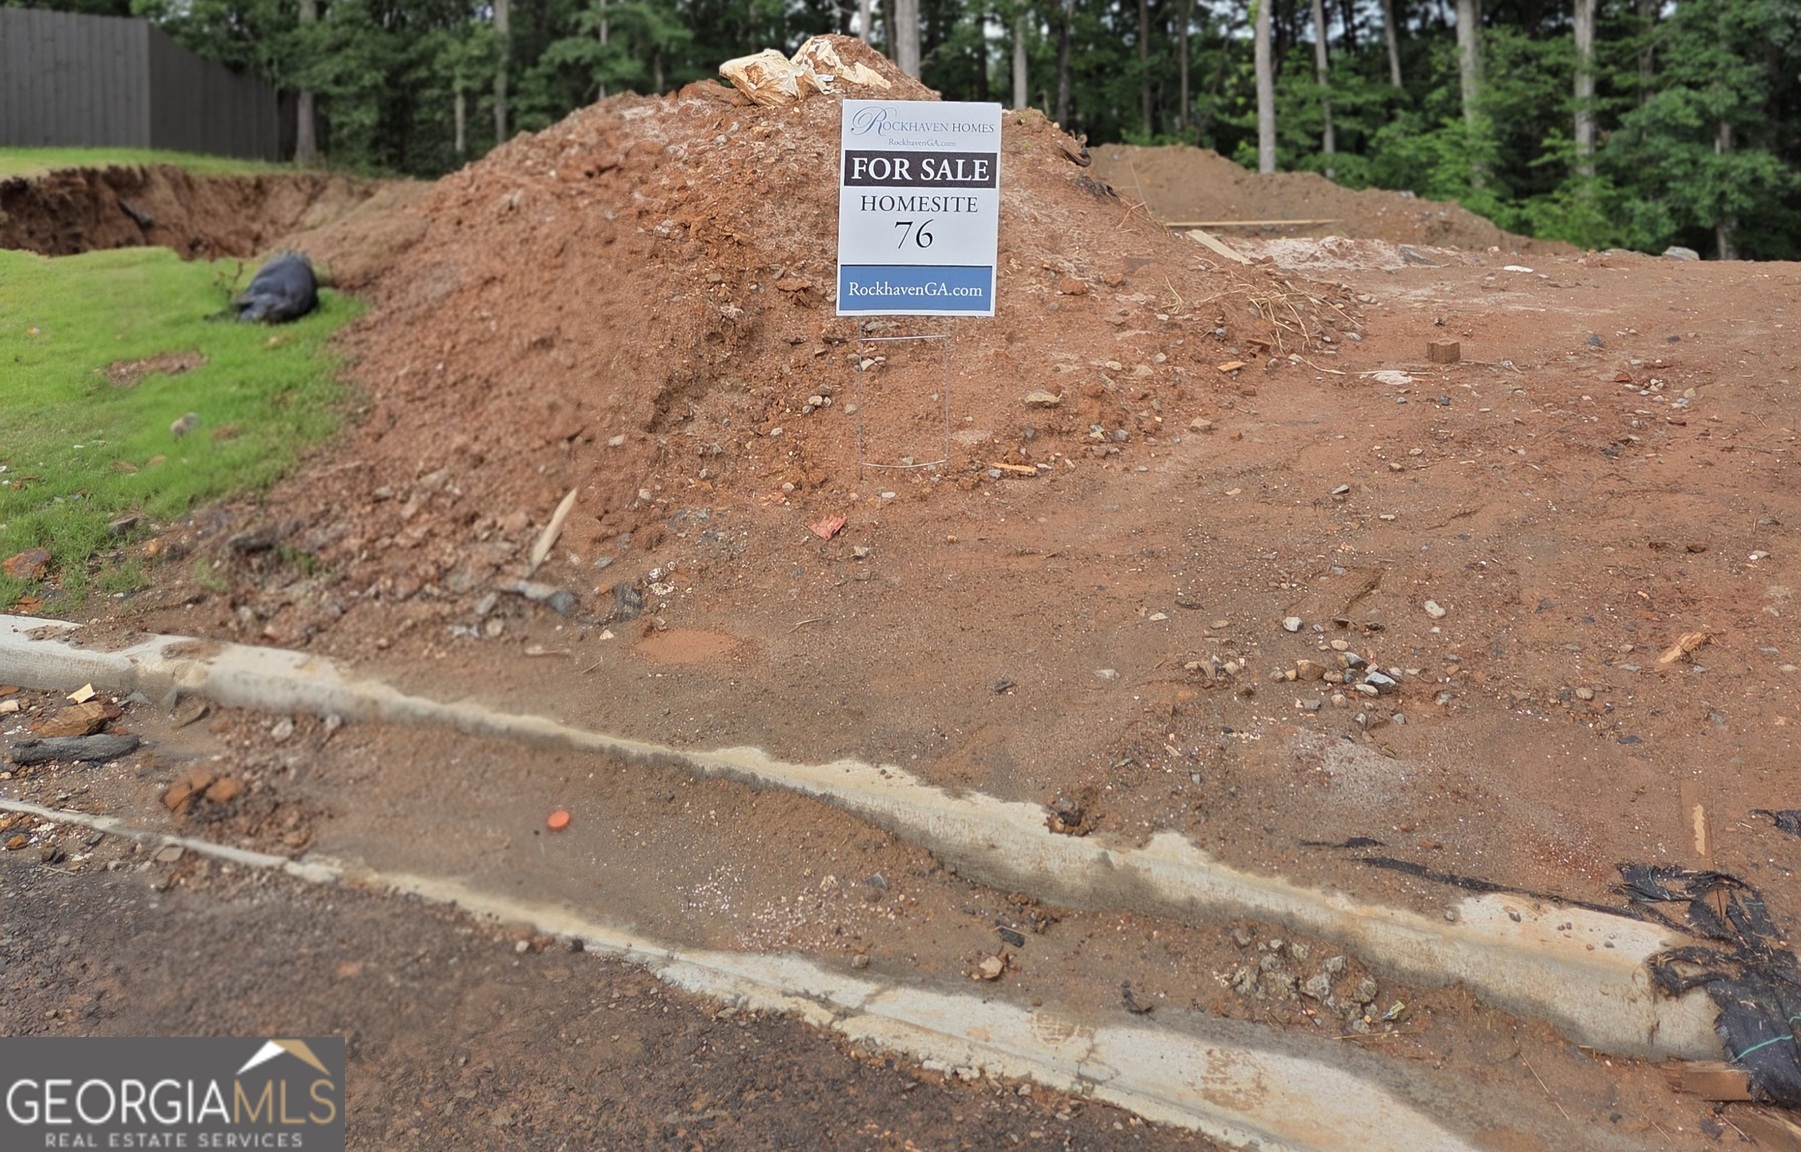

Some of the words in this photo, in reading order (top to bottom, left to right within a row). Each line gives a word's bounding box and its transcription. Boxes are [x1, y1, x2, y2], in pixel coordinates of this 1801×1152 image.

[850, 105, 949, 137] ROCKHAVEN
[952, 122, 995, 134] HOMES
[888, 137, 956, 147] RockhavenGA.com
[851, 157, 913, 181] FOR
[920, 158, 990, 182] SALE
[860, 195, 979, 213] HOMESITE
[894, 218, 935, 250] 76
[849, 281, 983, 298] RockhavenGA.com
